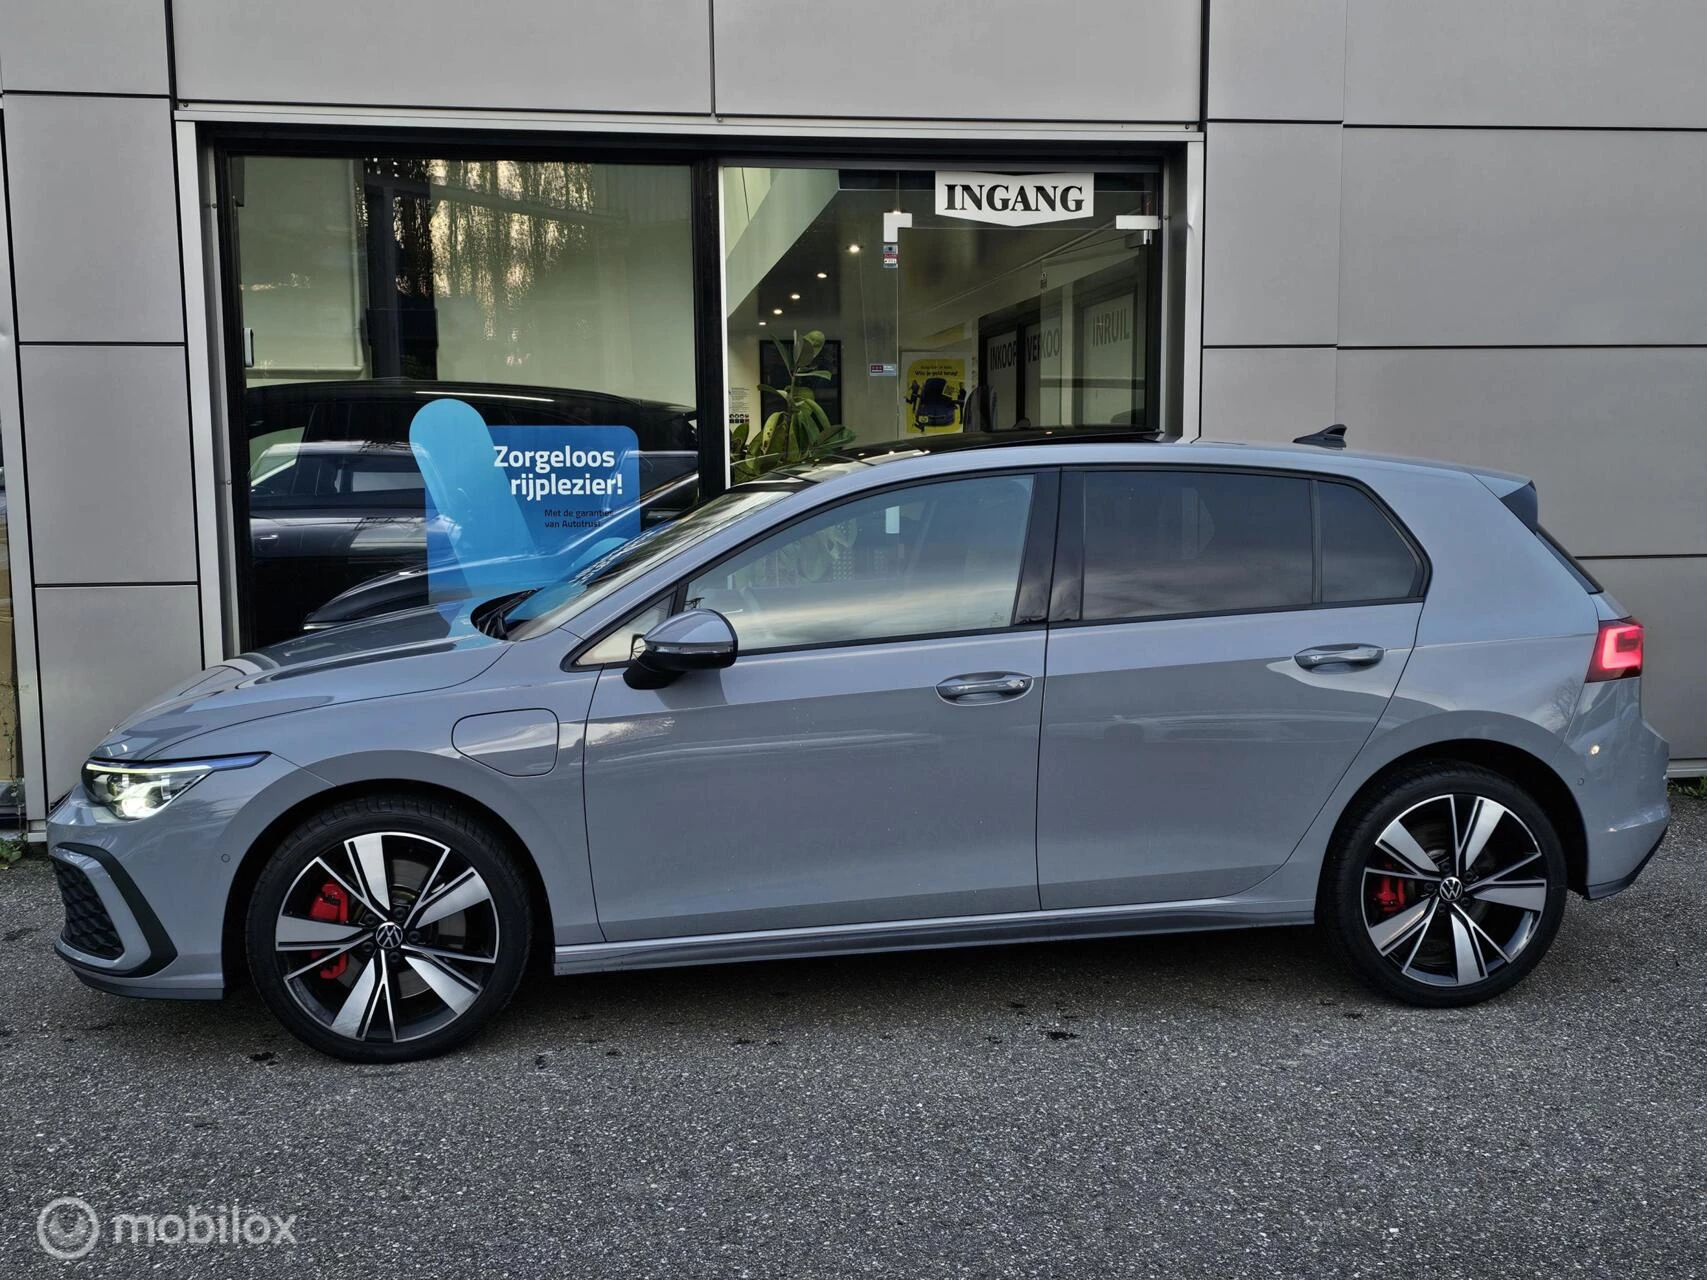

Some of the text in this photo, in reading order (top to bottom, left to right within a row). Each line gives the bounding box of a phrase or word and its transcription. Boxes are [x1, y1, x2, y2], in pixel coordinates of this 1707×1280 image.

[944, 184, 1085, 212] INGANG
[1093, 307, 1130, 347] INRUIL
[493, 445, 615, 473] Zorgeloos
[511, 473, 623, 501] rijplezier!
[544, 509, 561, 517] Met
[563, 509, 573, 517] de
